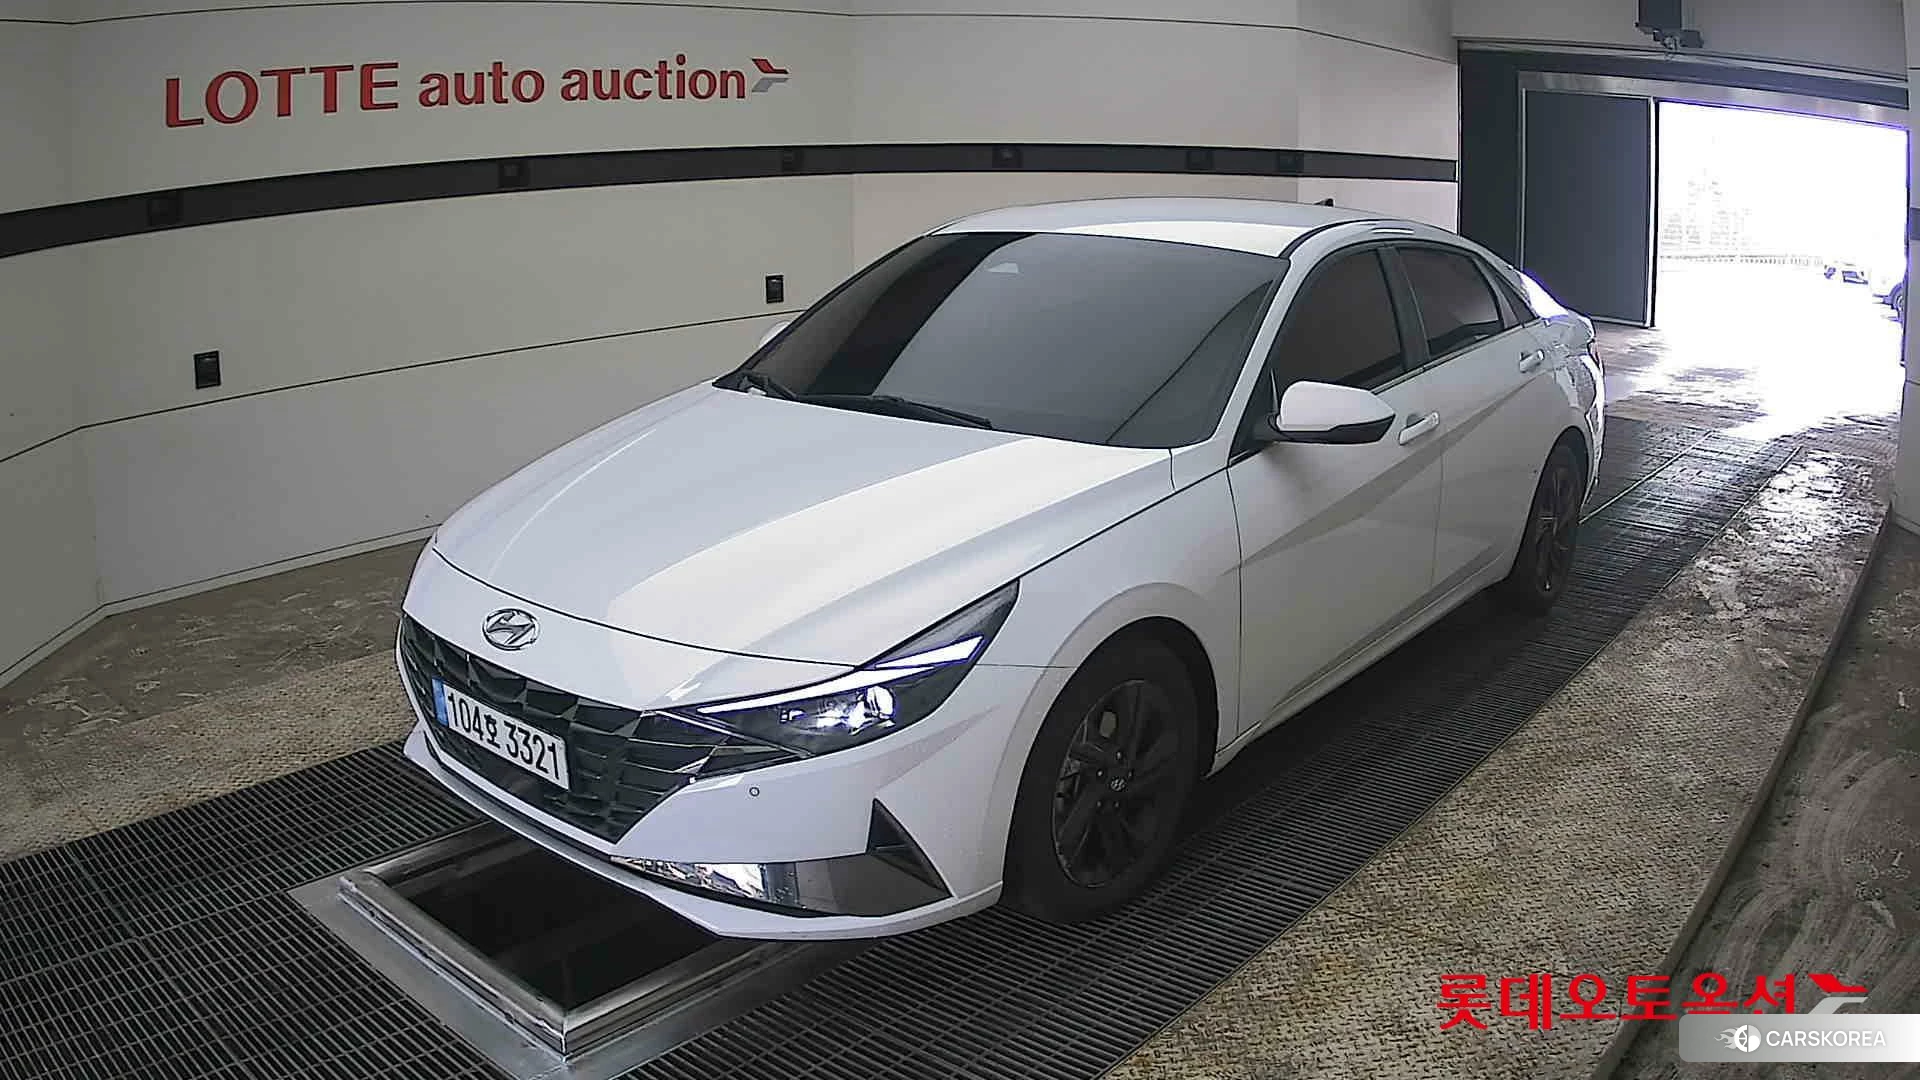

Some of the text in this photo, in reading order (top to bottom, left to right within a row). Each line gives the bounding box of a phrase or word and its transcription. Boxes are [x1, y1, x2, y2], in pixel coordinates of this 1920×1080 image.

[166, 53, 746, 128] LOTTE auto auction
[503, 719, 560, 780] 3321
